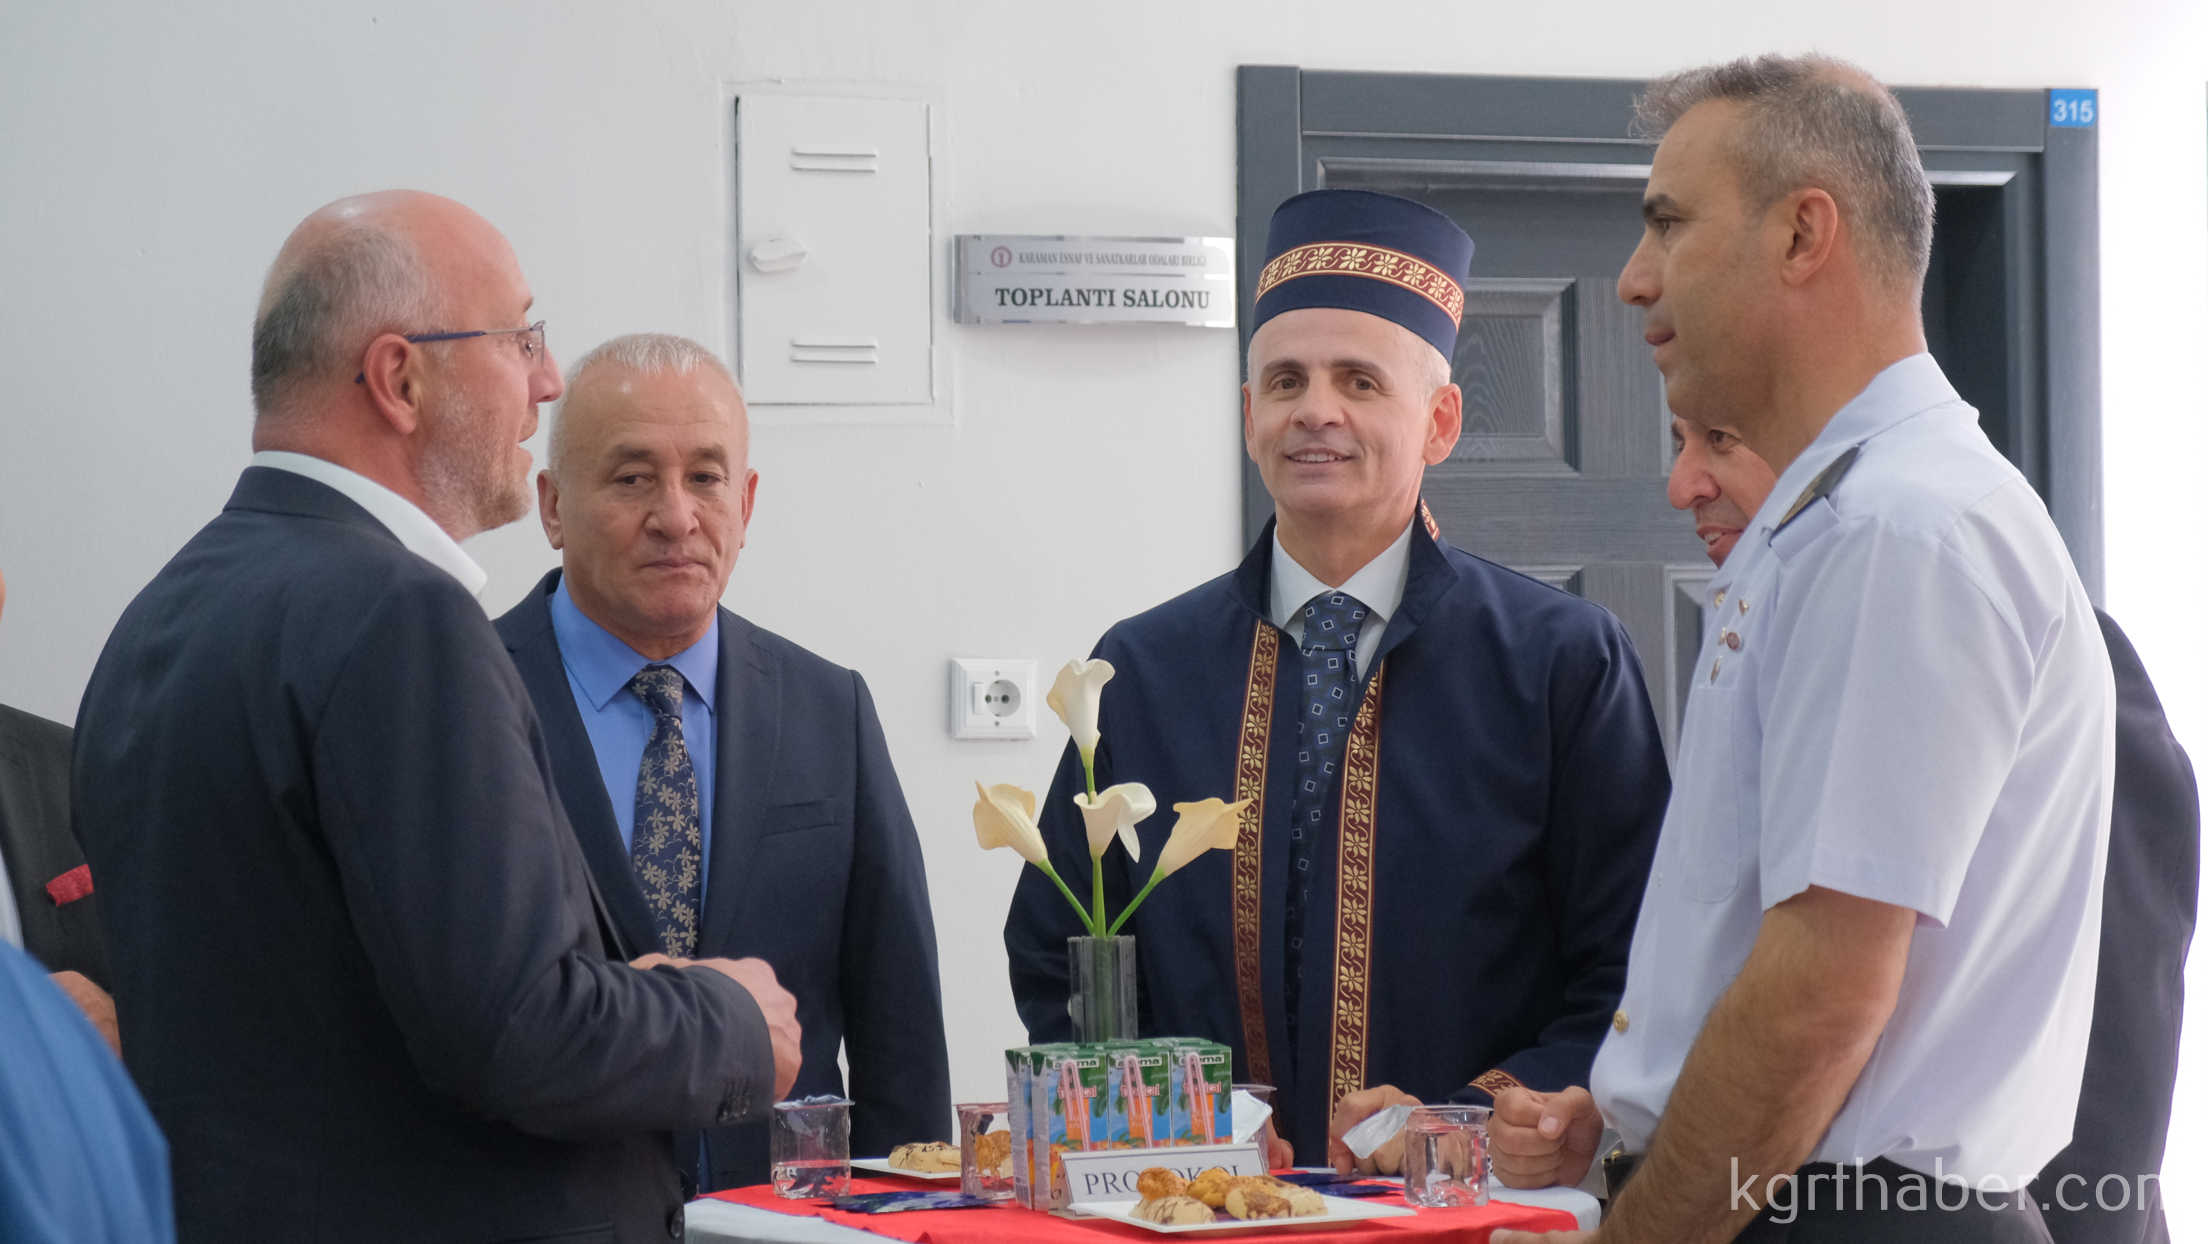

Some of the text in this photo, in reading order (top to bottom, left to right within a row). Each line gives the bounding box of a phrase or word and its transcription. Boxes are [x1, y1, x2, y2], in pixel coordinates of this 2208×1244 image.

[2053, 98, 2094, 122] 315
[995, 287, 1211, 309] TOPLANTI SALONU
